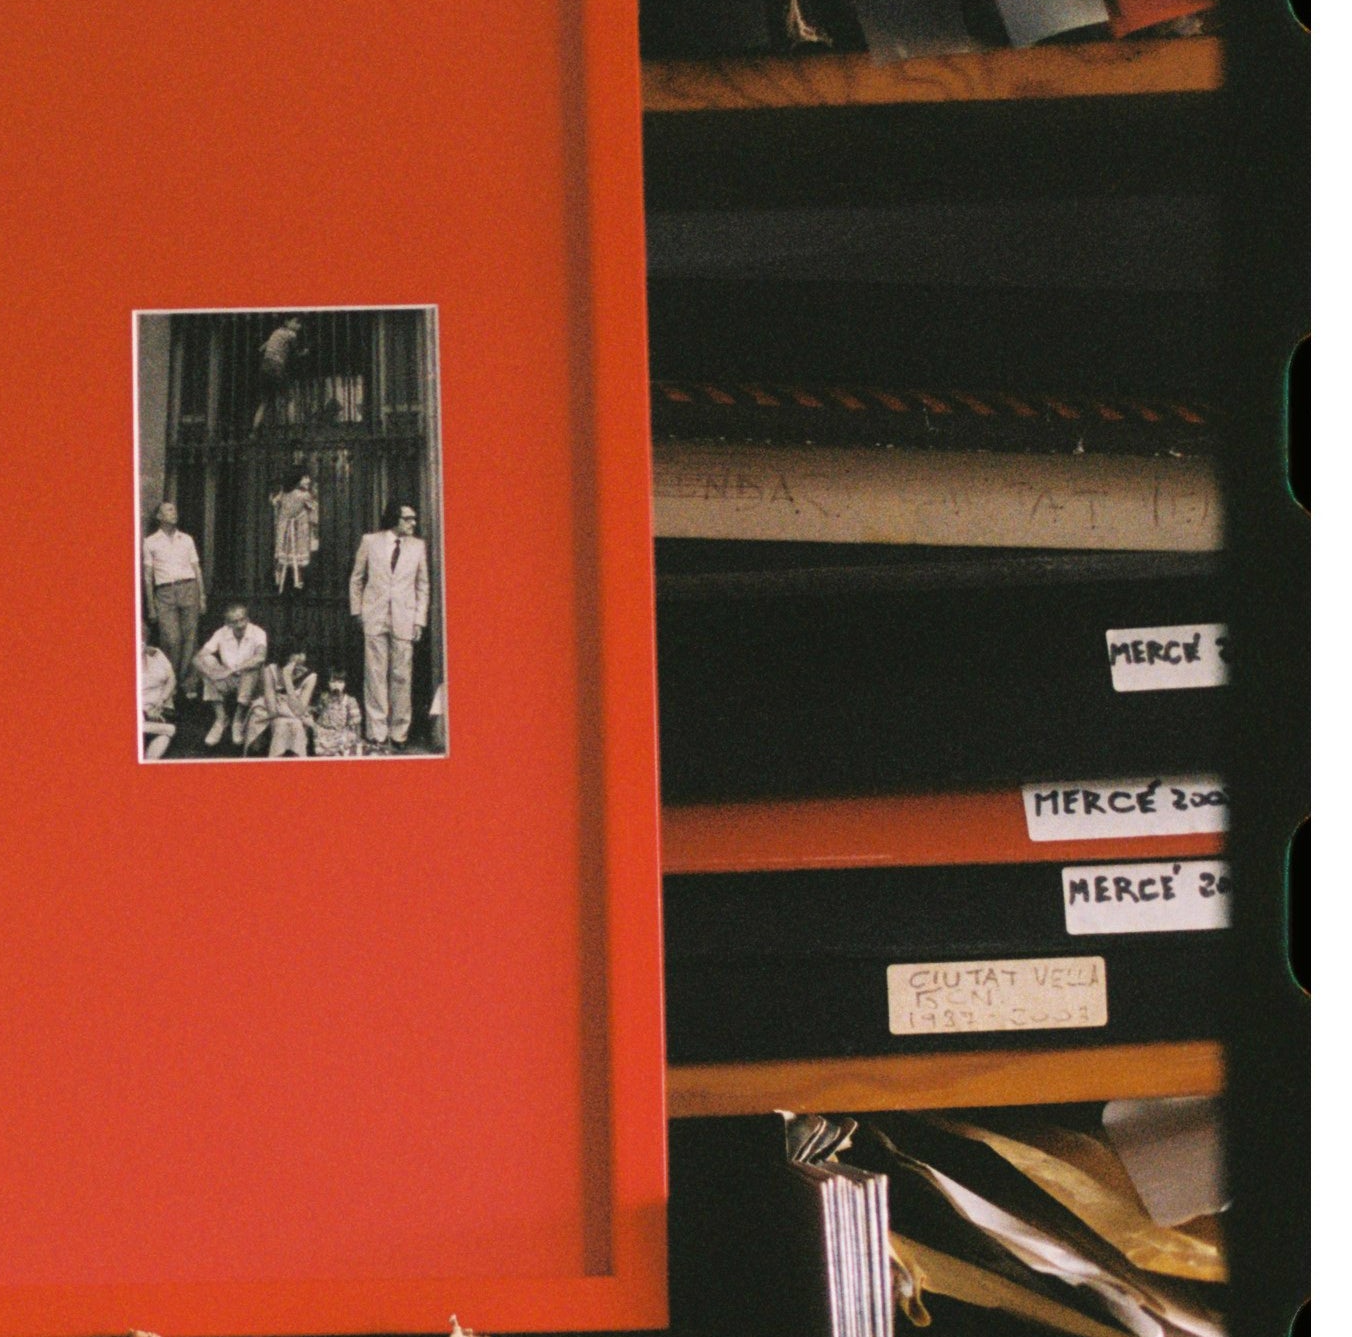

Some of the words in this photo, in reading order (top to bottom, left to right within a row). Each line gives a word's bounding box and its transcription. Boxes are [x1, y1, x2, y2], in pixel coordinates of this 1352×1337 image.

[1034, 780, 1162, 816] MERCÉ
[1068, 864, 1182, 905] MERCÉ
[908, 968, 1018, 989] CIUTAT
